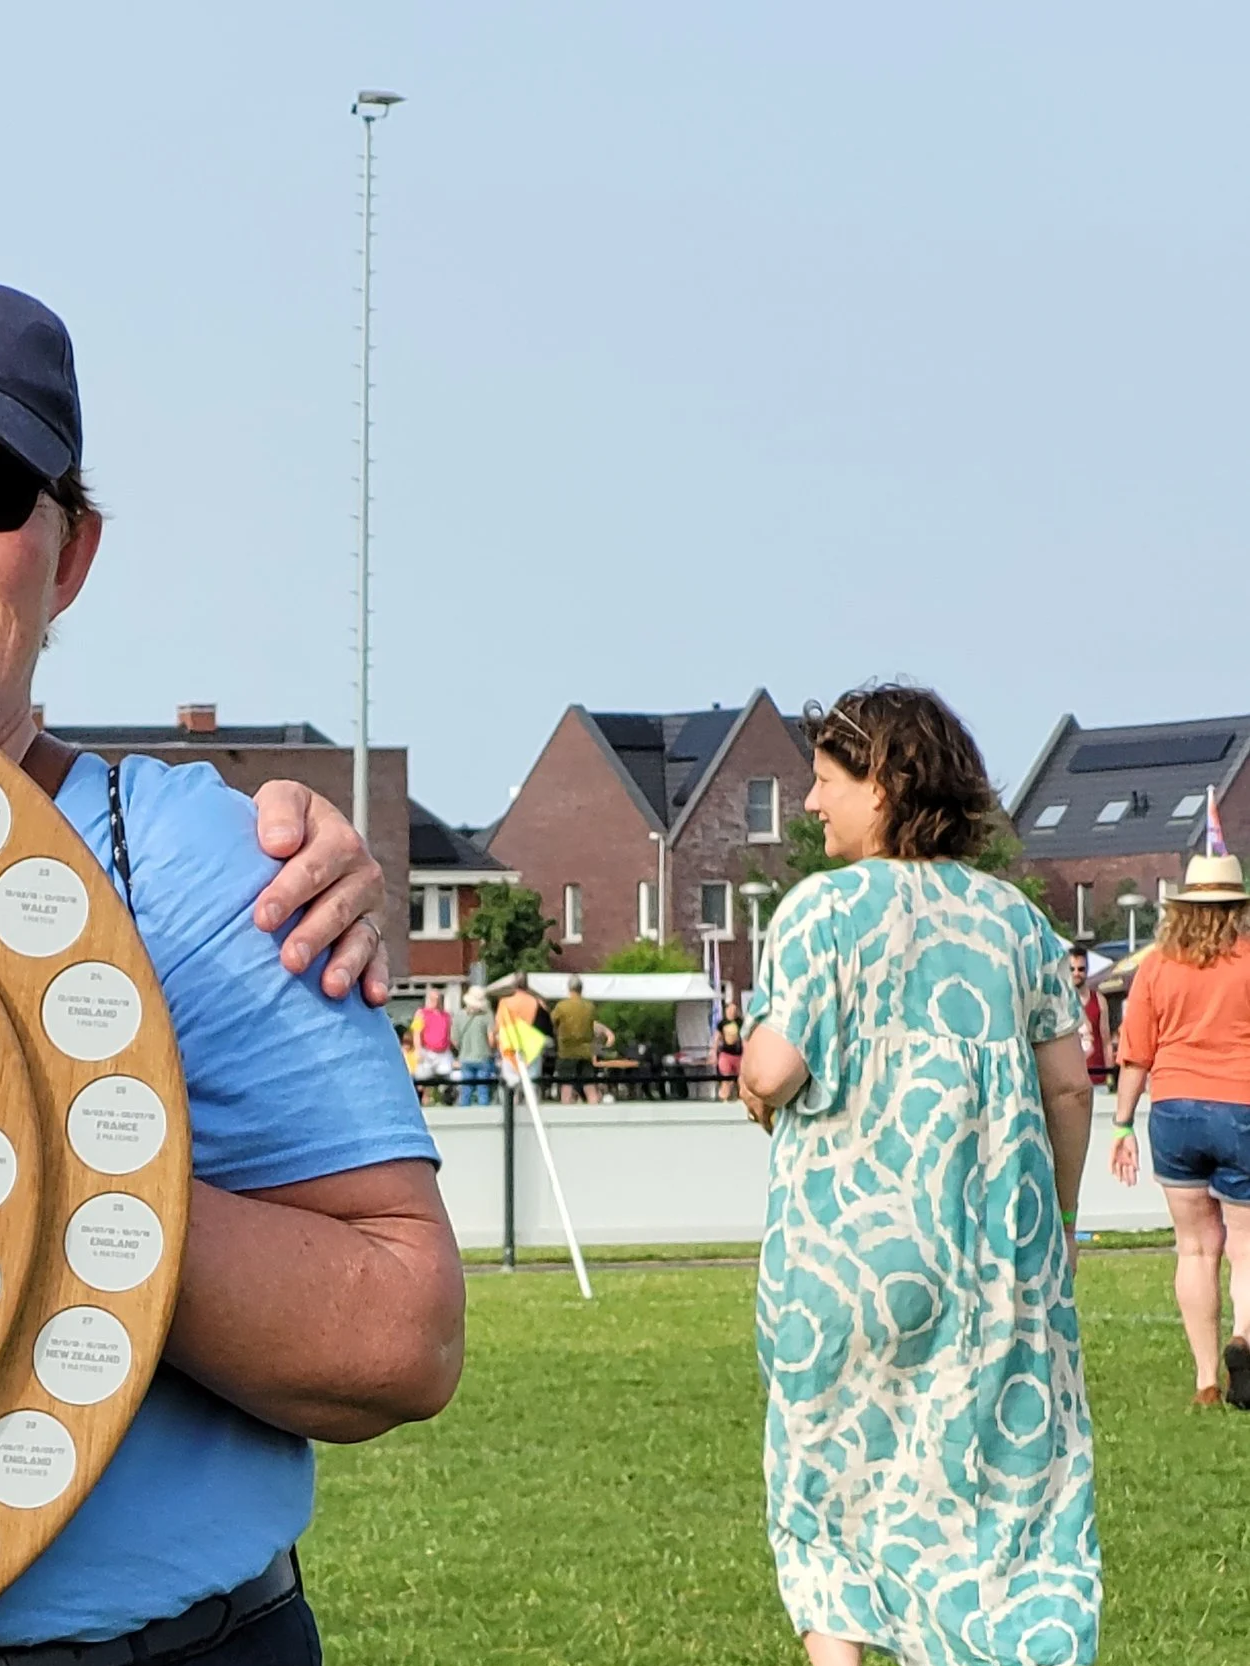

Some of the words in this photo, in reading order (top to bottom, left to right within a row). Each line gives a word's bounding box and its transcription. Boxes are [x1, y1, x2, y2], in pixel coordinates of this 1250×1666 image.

[20, 902, 58, 915] WALES
[68, 1005, 118, 1019] ENGLAND
[96, 1119, 138, 1132] FRANCE
[89, 1236, 140, 1250] ENGLAND
[46, 1347, 69, 1360] NEW
[71, 1350, 120, 1365] ZEALAND
[2, 1452, 52, 1467] ENGLAND
